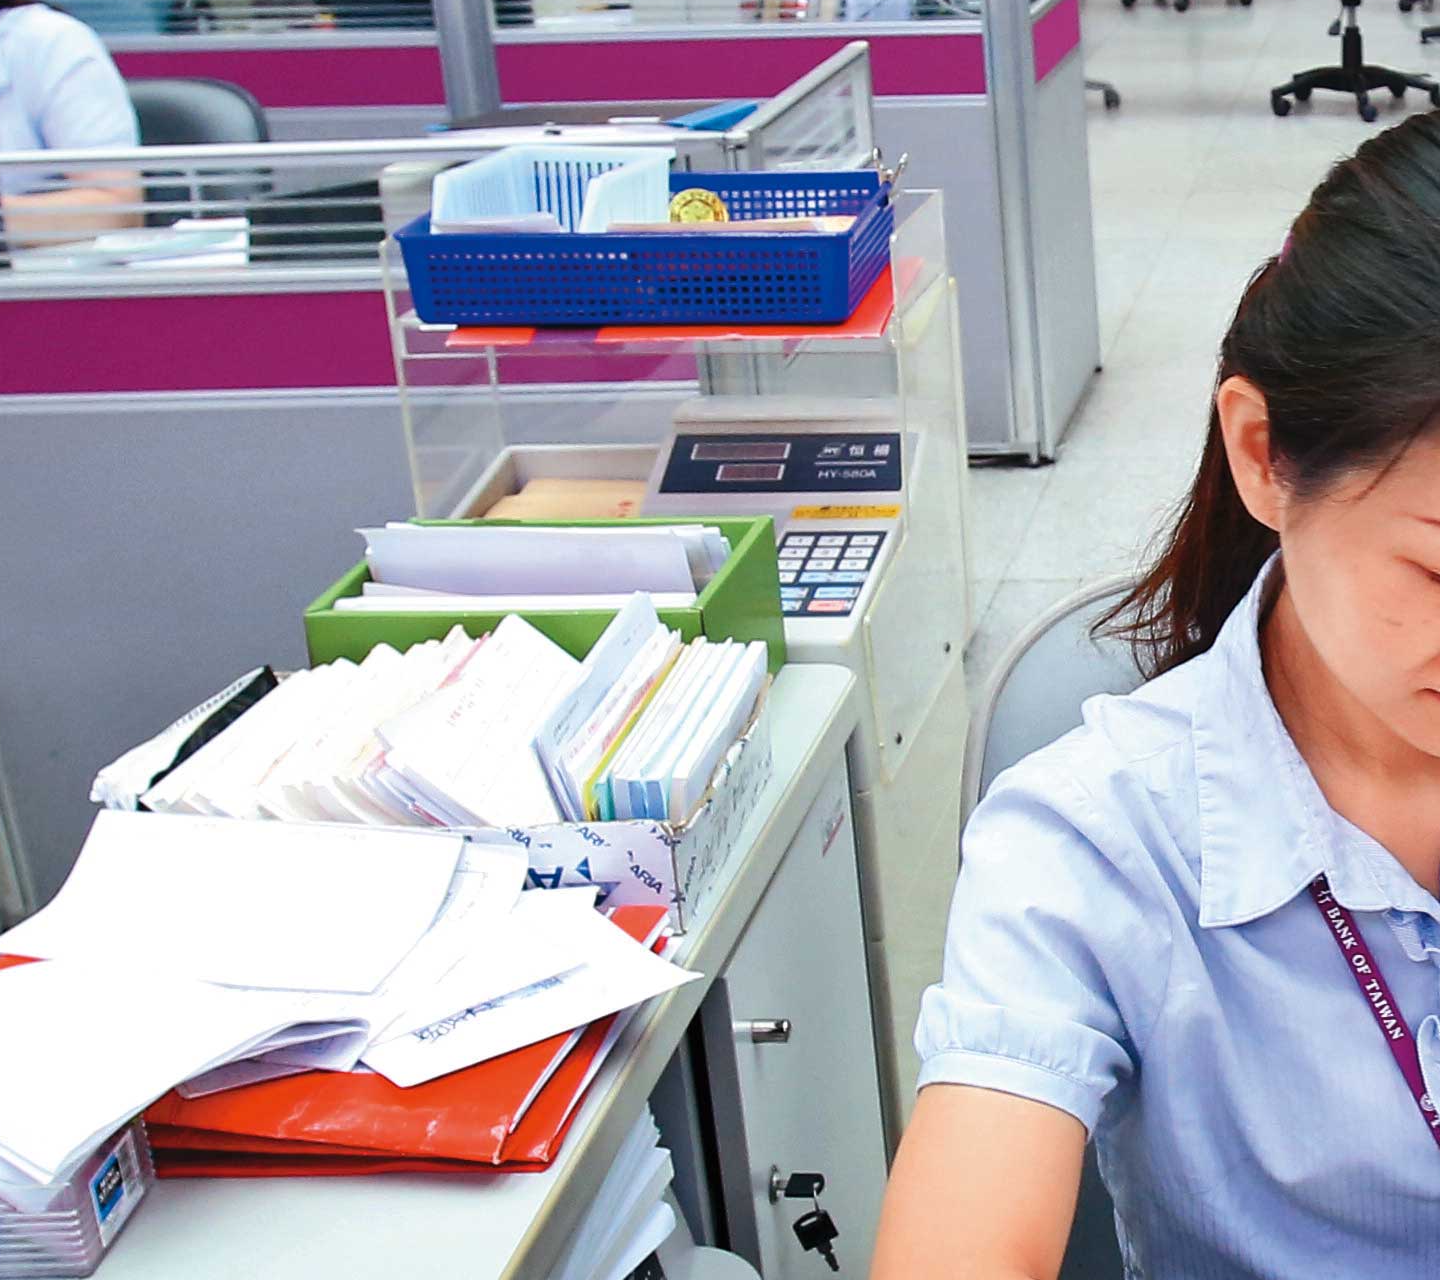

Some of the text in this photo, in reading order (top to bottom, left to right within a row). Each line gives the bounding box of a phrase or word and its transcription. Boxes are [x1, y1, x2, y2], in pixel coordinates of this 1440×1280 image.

[629, 863, 663, 895] ARIA
[1326, 905, 1358, 951] BANK
[1351, 952, 1373, 977] OF
[1363, 976, 1406, 1043] TAIWAN
